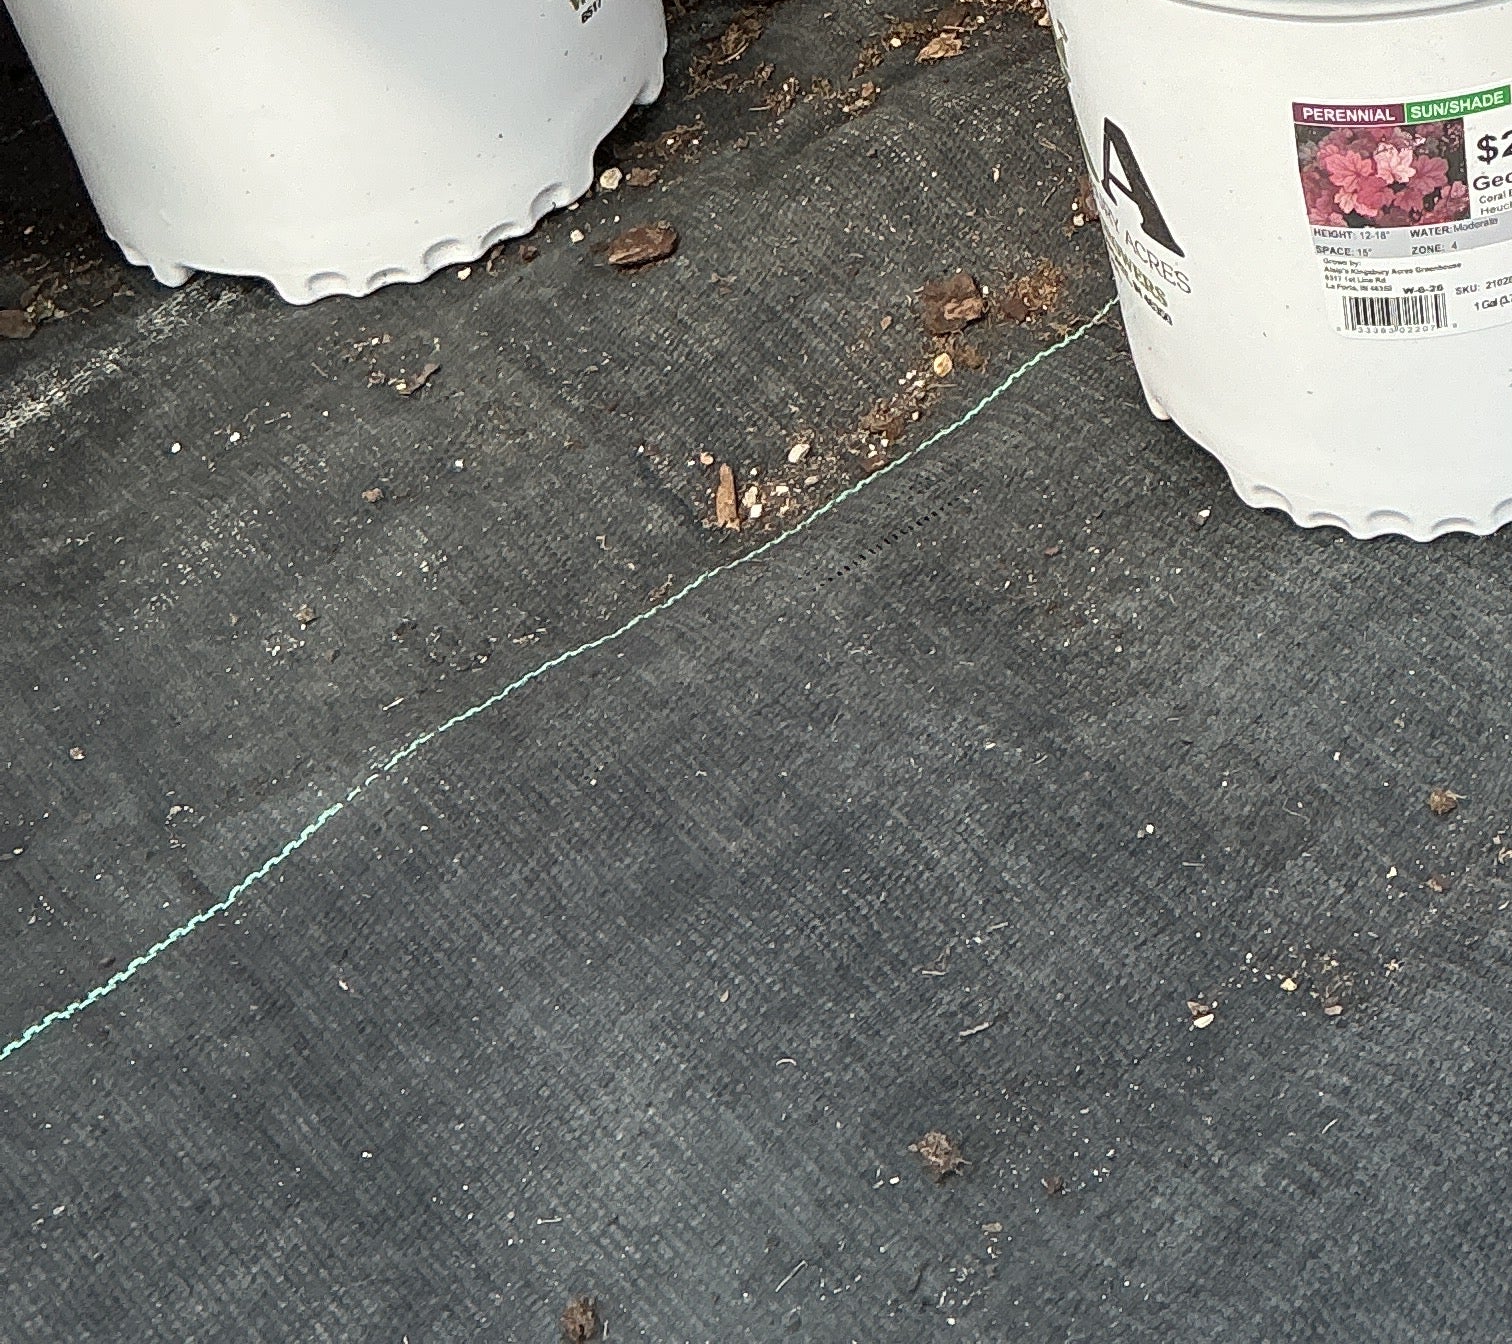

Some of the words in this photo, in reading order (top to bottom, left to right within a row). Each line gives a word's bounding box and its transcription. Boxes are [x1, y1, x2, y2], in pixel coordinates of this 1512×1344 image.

[1410, 90, 1504, 119] SUN/SHADE
[1303, 107, 1396, 122] PERENNIAL
[1479, 190, 1506, 205] Coral
[1453, 217, 1499, 233] Moderate
[1313, 227, 1356, 240] HEIGHT:
[1315, 245, 1355, 257] SPACE:
[1411, 244, 1446, 256] ZONE:
[1450, 241, 1458, 250] 4
[1125, 229, 1192, 294] ACRES
[1455, 283, 1481, 296] SKU:
[1481, 298, 1498, 310] Gal
